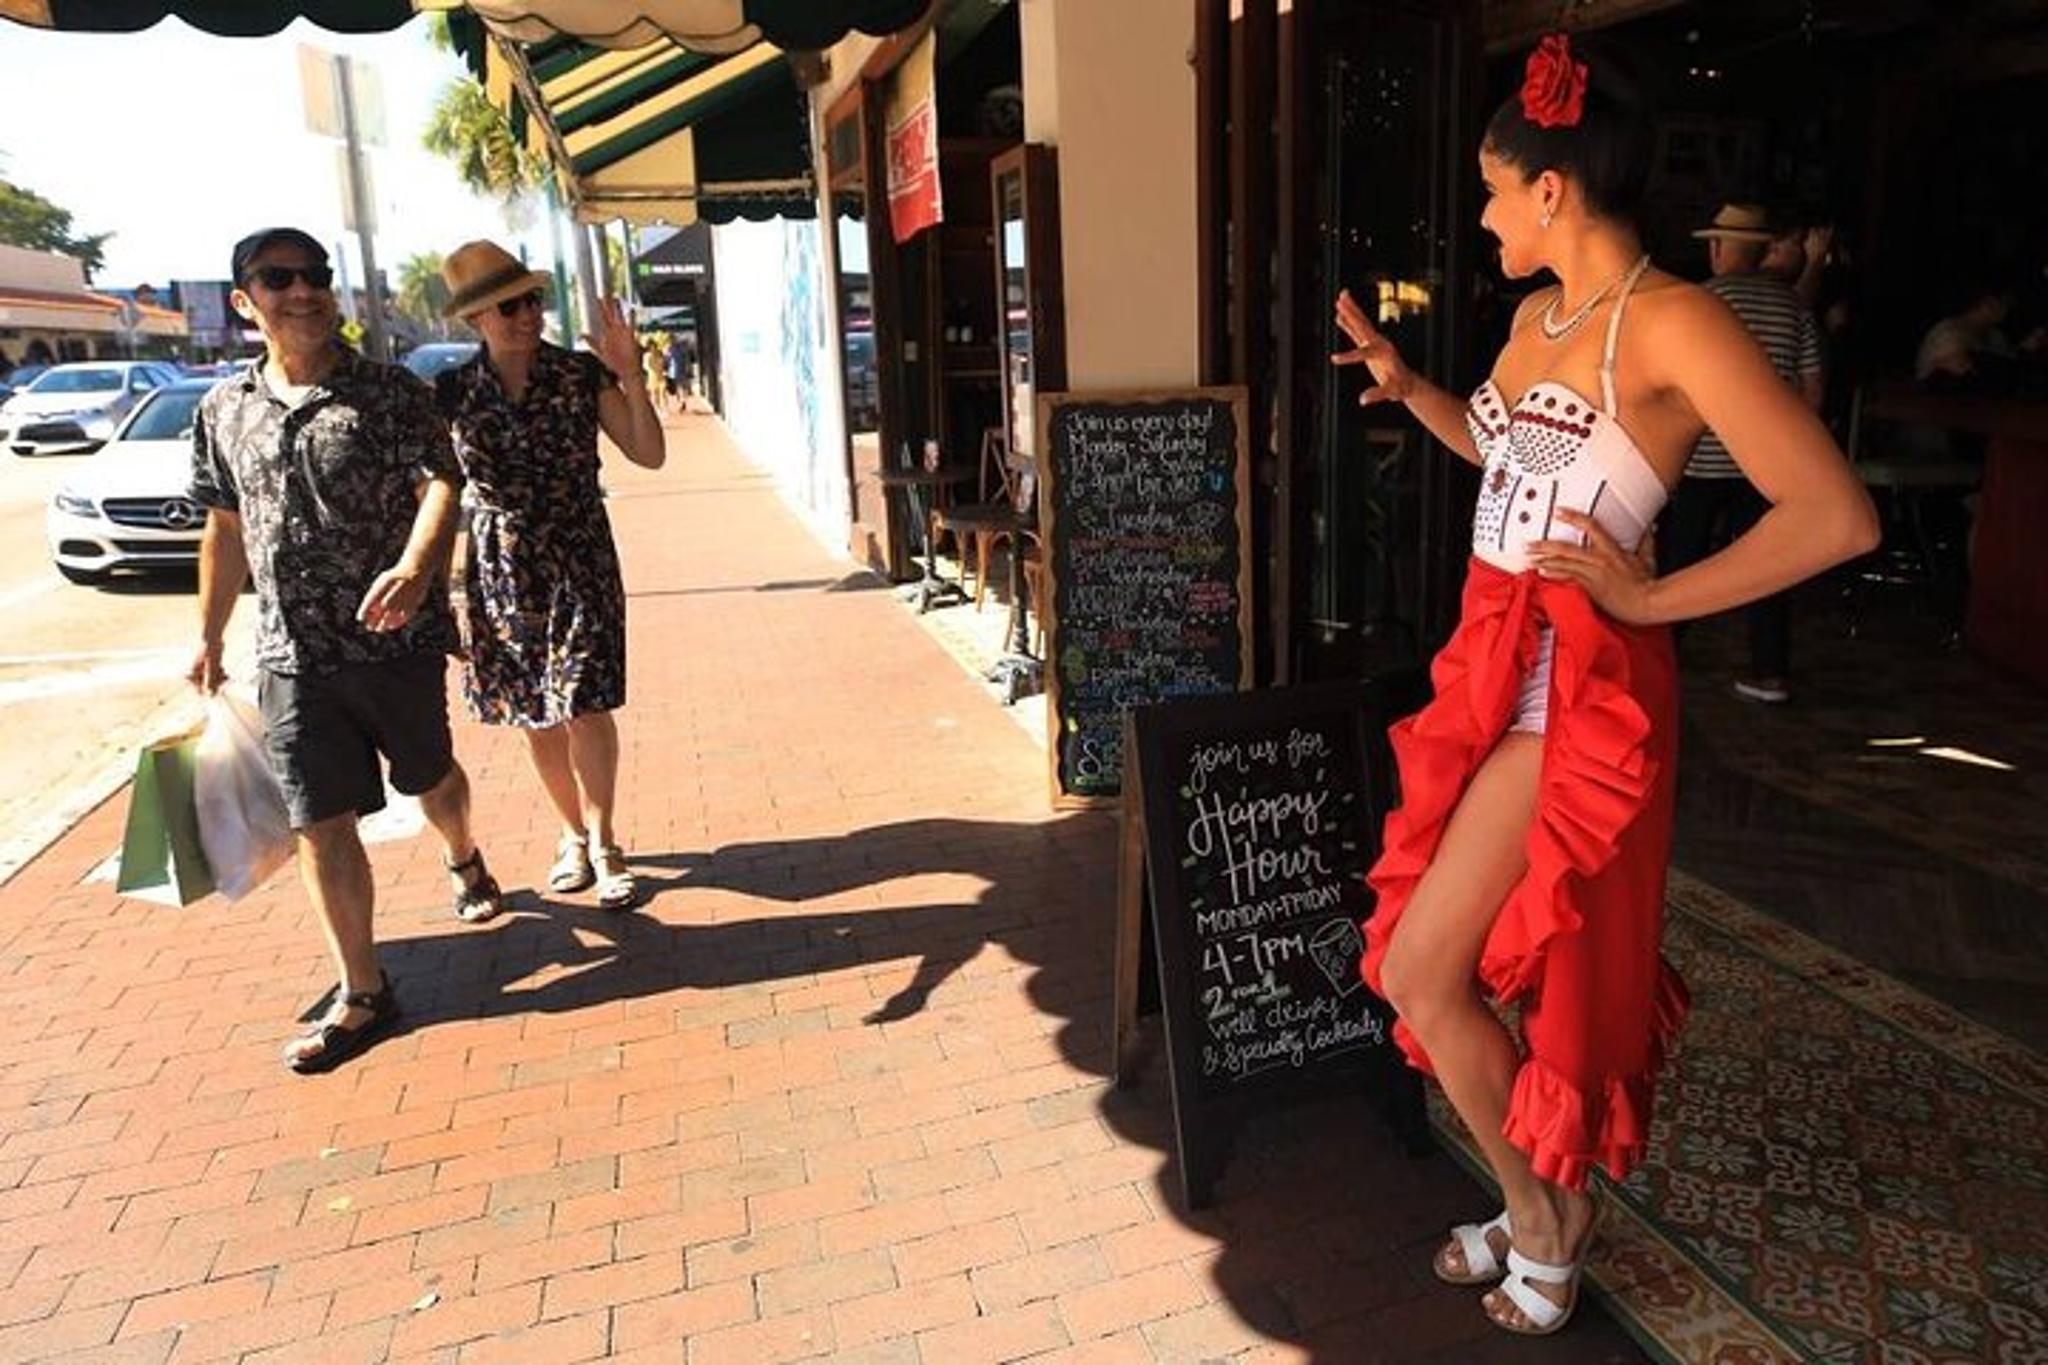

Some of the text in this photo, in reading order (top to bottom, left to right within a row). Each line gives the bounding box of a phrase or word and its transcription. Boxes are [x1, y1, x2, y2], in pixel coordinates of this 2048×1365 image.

[1067, 405, 1213, 437] Join us every day!
[1189, 727, 1332, 794] join us for
[1187, 789, 1330, 857] Happy
[1220, 840, 1333, 905] Hour
[1201, 985, 1236, 1020] 2
